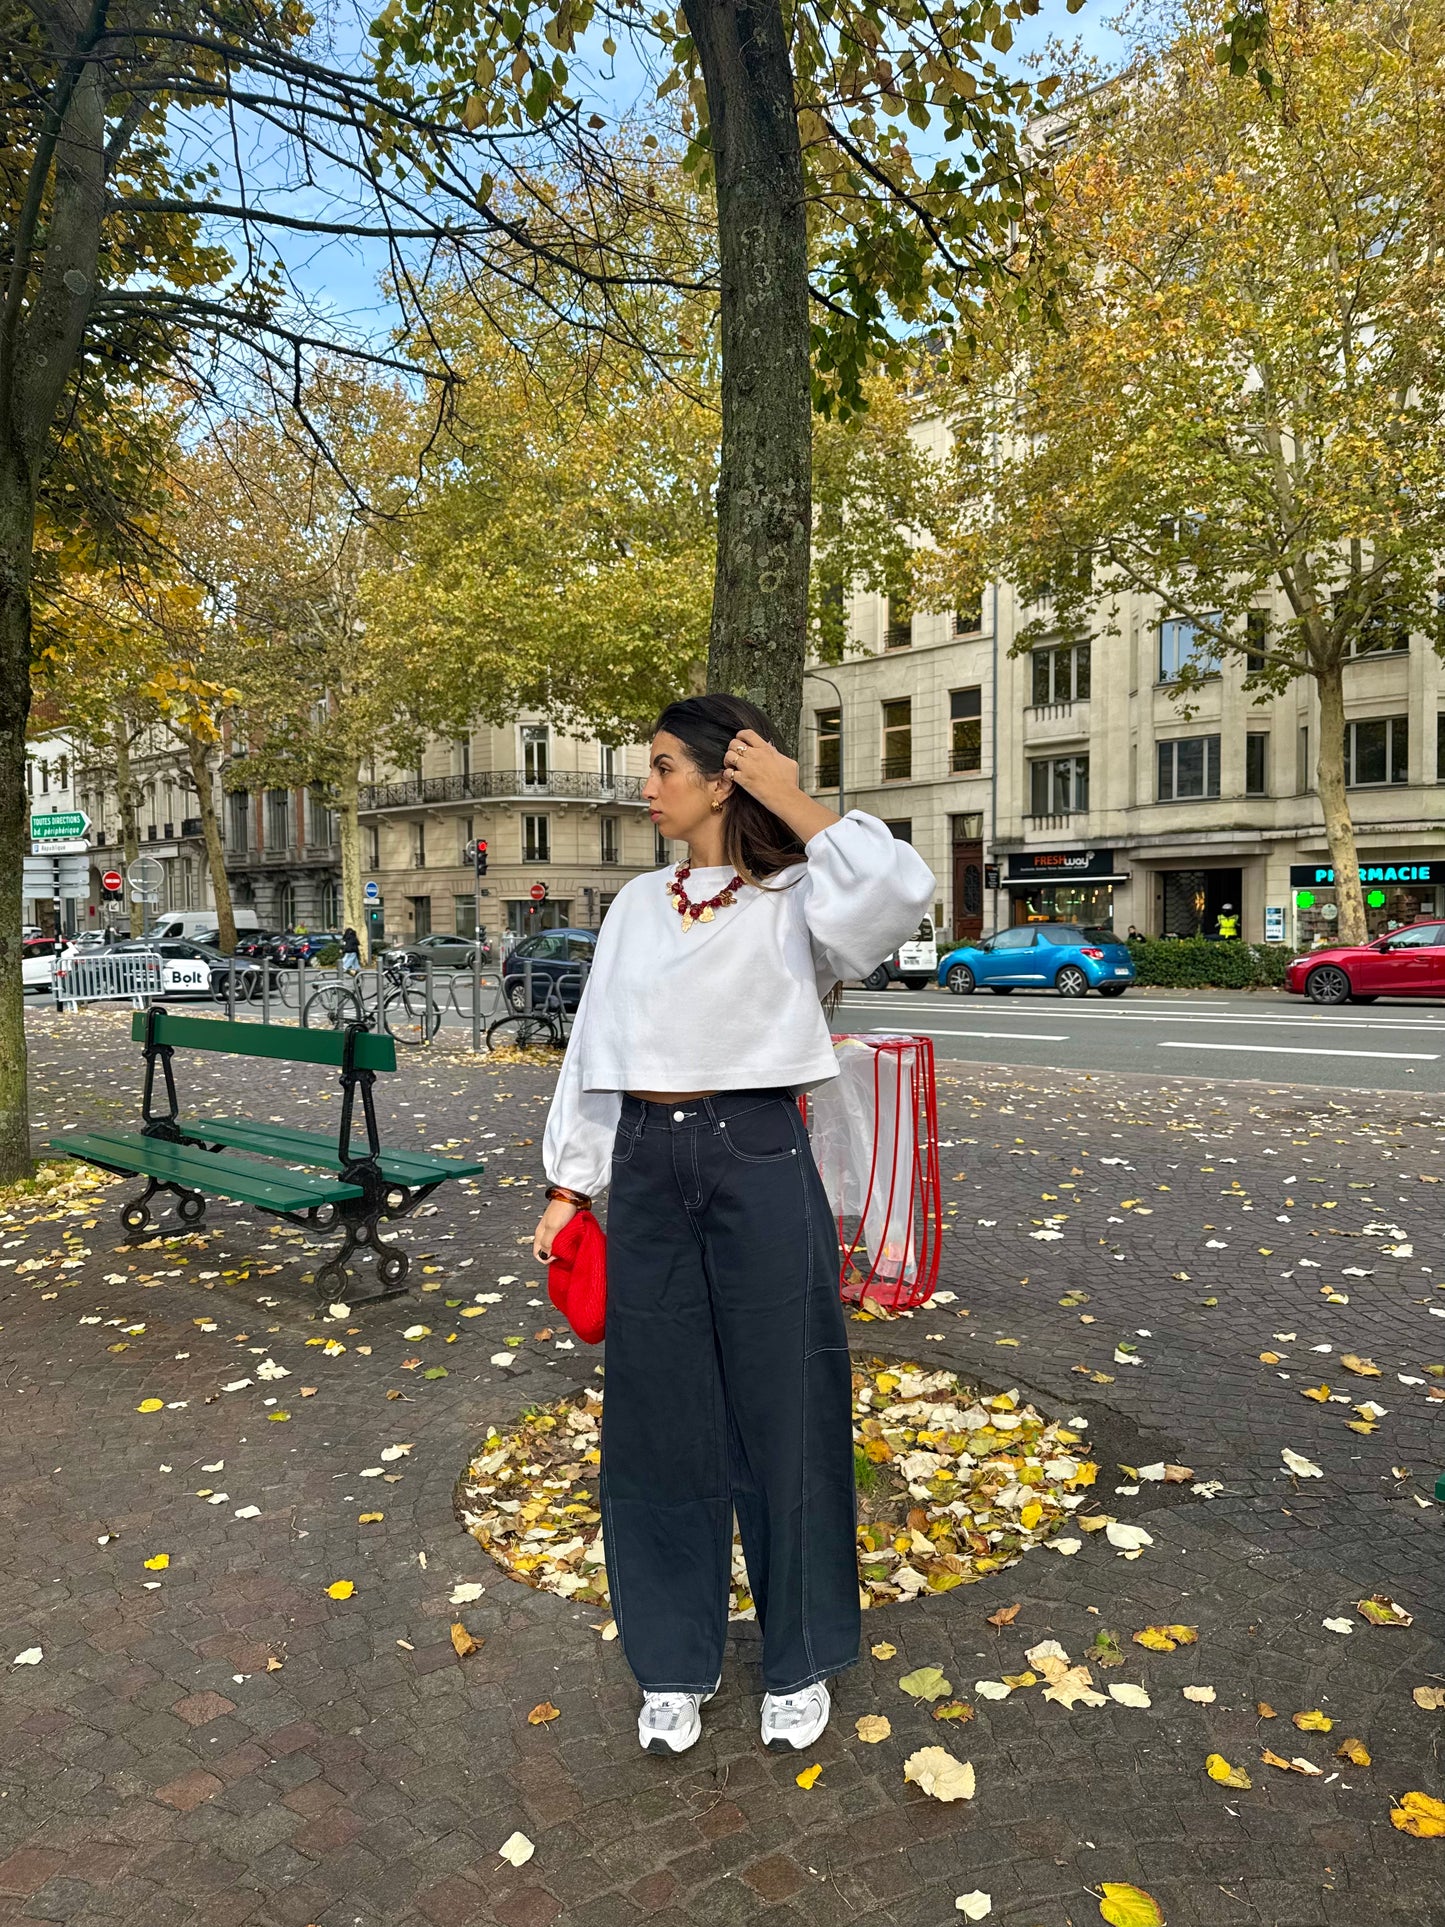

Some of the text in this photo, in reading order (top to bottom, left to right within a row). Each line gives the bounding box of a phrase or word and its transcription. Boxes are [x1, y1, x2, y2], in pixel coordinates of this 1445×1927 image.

[33, 815, 80, 826] TOUTES DIRECTIONS
[43, 826, 79, 836] périphérique
[1315, 866, 1430, 882] PHRMACIE
[172, 971, 203, 983] Bolt
